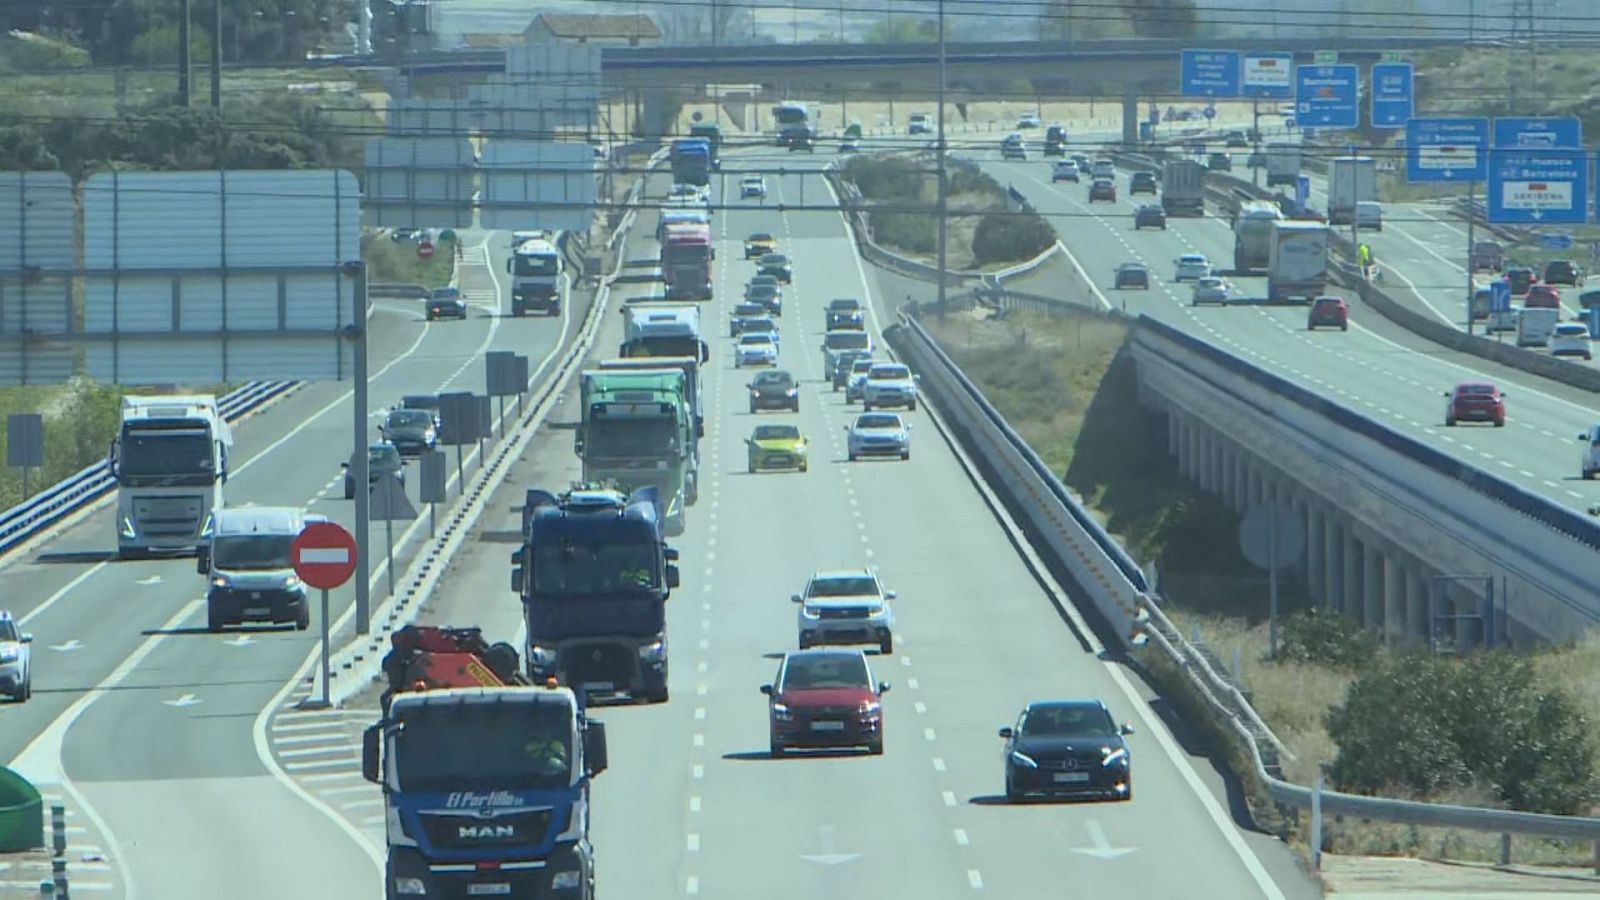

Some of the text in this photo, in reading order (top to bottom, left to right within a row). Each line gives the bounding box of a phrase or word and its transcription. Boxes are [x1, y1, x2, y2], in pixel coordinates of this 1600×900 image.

[1522, 169, 1577, 178] Barcelona
[446, 792, 462, 809] El
[458, 825, 514, 838] MAN
